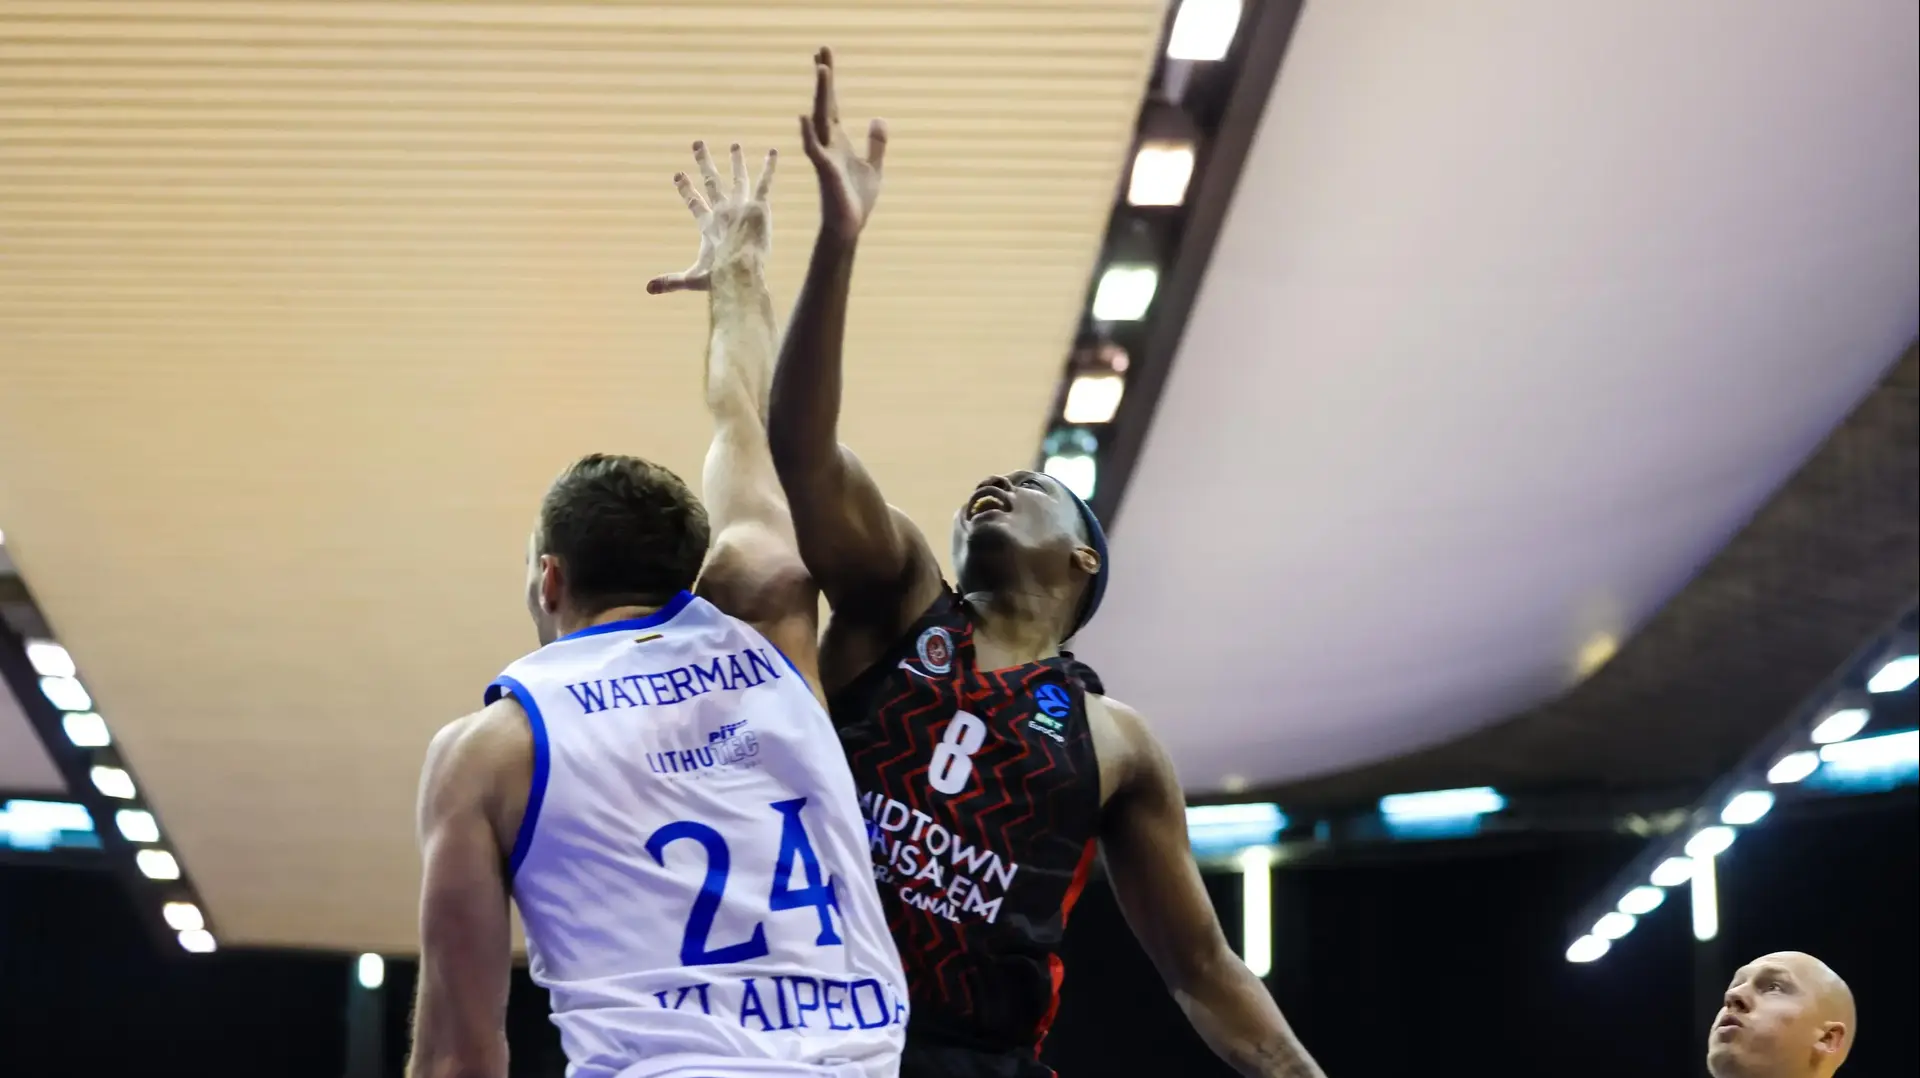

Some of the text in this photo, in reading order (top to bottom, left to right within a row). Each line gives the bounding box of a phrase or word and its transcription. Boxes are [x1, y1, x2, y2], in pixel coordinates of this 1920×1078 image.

[565, 649, 781, 714] WATERMAN
[645, 730, 759, 773] LITHUTEC
[928, 709, 987, 794] 8
[644, 796, 843, 967] 24
